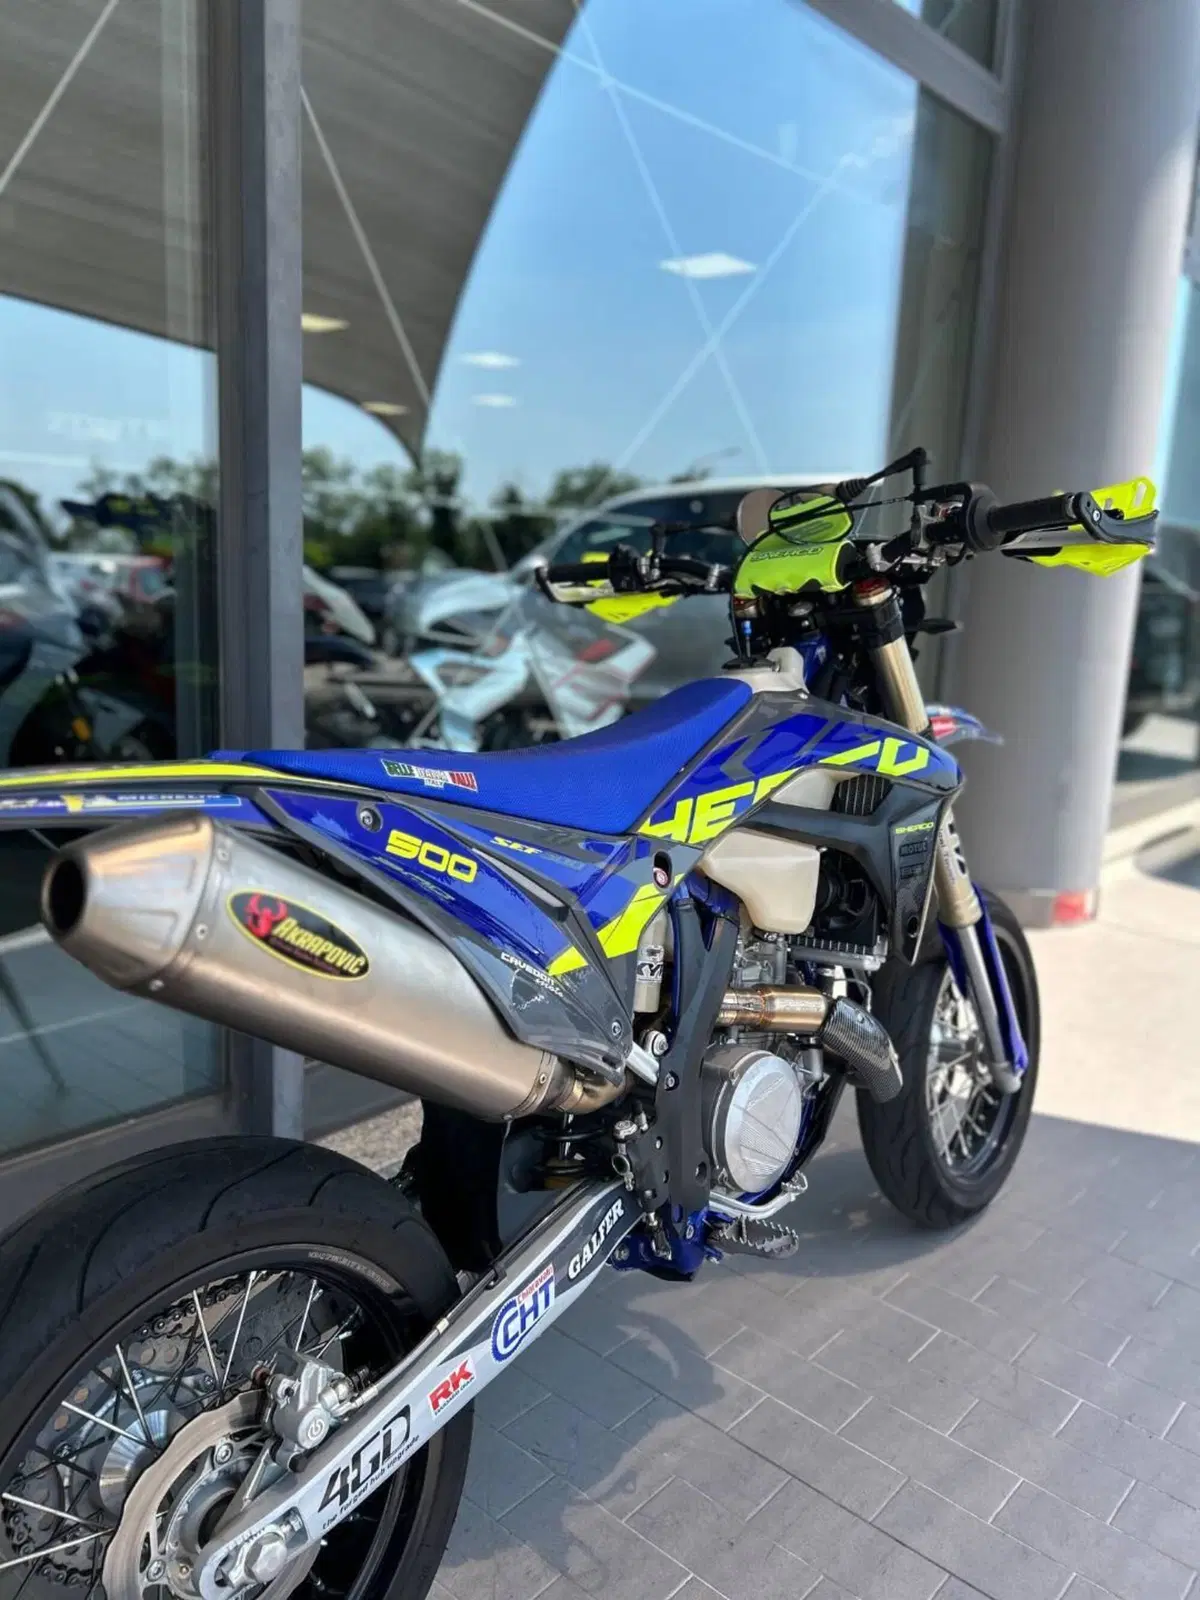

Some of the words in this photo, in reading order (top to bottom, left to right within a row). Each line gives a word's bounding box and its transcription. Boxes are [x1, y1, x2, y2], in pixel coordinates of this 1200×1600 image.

[385, 829, 479, 884] 500
[567, 1198, 624, 1280] GALFER
[503, 1275, 554, 1350] CHT
[429, 1359, 473, 1411] RK
[317, 1404, 411, 1513] 4GD
[322, 1514, 338, 1531] the
[340, 1482, 369, 1514] forged
[370, 1467, 386, 1487] hub
[387, 1434, 420, 1470] upgrade
